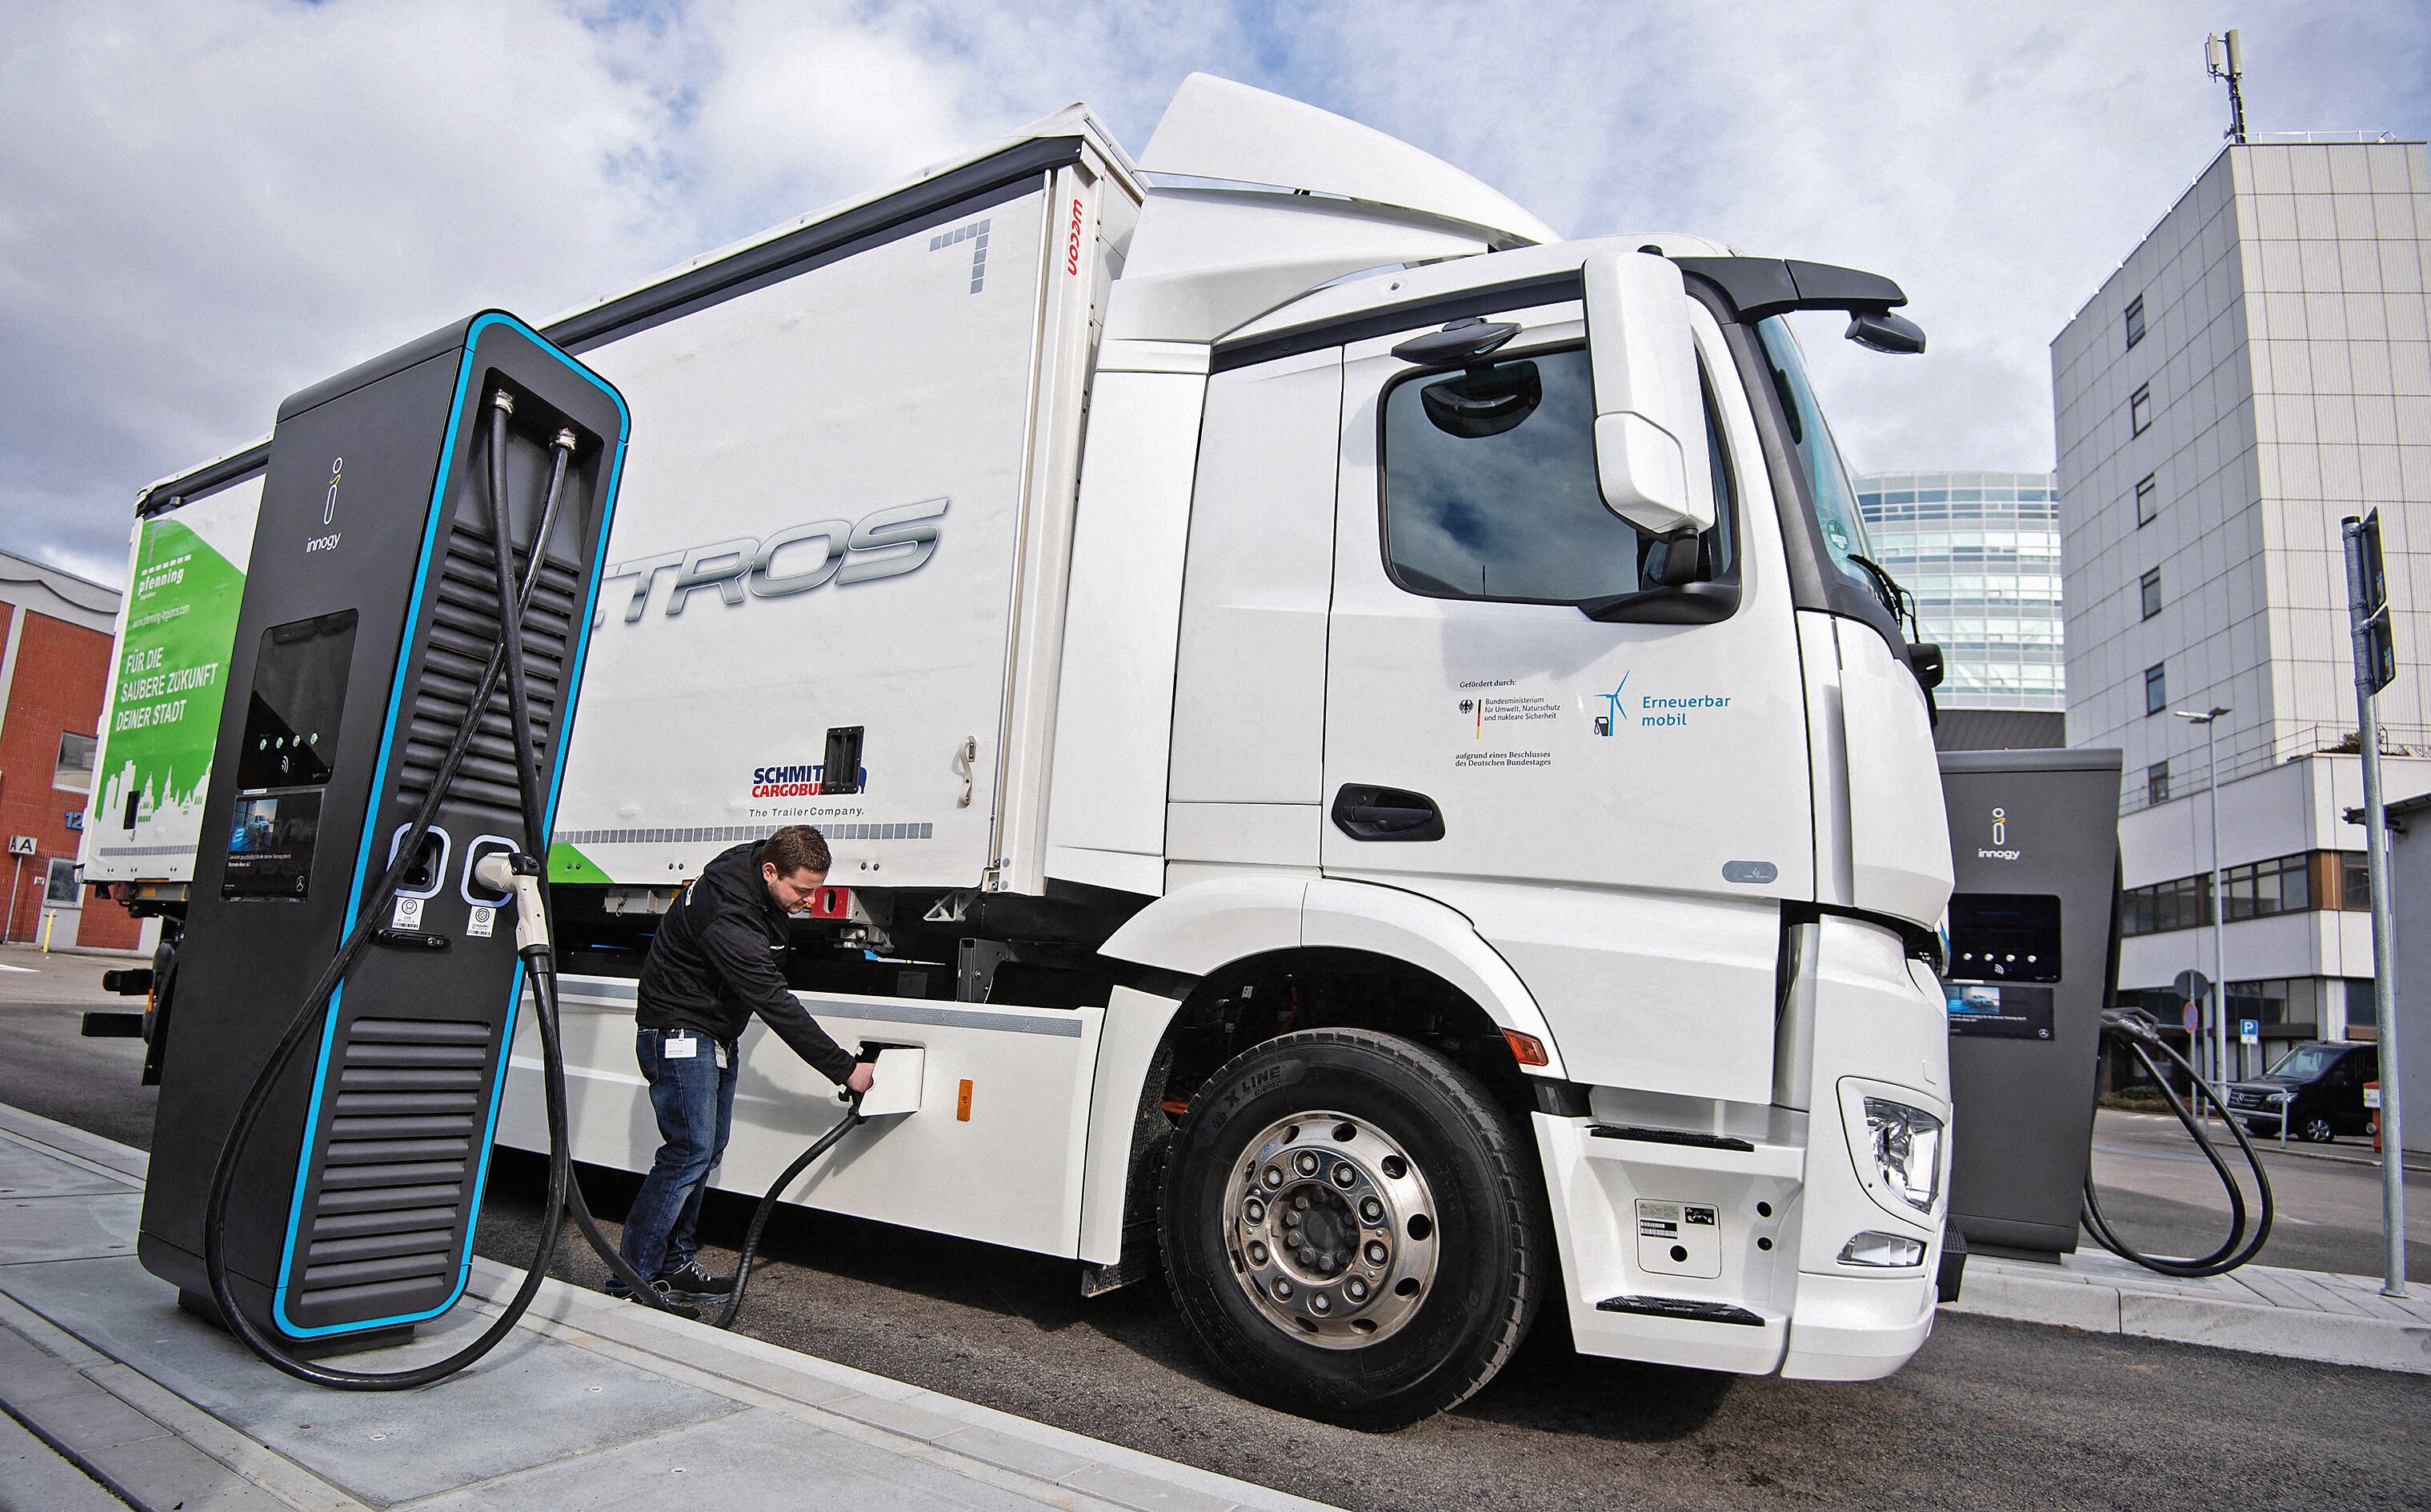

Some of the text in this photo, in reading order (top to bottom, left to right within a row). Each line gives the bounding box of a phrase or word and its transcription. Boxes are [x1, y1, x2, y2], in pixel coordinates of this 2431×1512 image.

[1067, 198, 1083, 276] wecon
[306, 533, 342, 553] innogy
[594, 497, 949, 629] TROS
[138, 568, 185, 596] pfenning
[126, 646, 164, 674] FÜR DIE
[121, 662, 218, 703] SAUBERE ZUKUNFT
[1485, 696, 1544, 705] Bundesministerium
[1643, 694, 1731, 708] Erneuerbar
[115, 699, 187, 732] DEINER STADT
[1495, 705, 1520, 713] Umwelt,
[1522, 704, 1560, 712] Naturschutz
[1525, 712, 1556, 720] Sicherheit
[1642, 713, 1687, 726] mobil
[1456, 752, 1488, 760] aufgrund
[1508, 750, 1551, 758] Beschlusses
[1506, 758, 1552, 766] Bundestages
[753, 765, 824, 784] SCHMIT
[751, 782, 823, 798] CARGOBU
[749, 809, 767, 818] The
[19, 838, 33, 852] A
[1978, 848, 2020, 860] innogy
[2244, 1021, 2253, 1034] P
[1241, 1066, 1280, 1093] LINE
